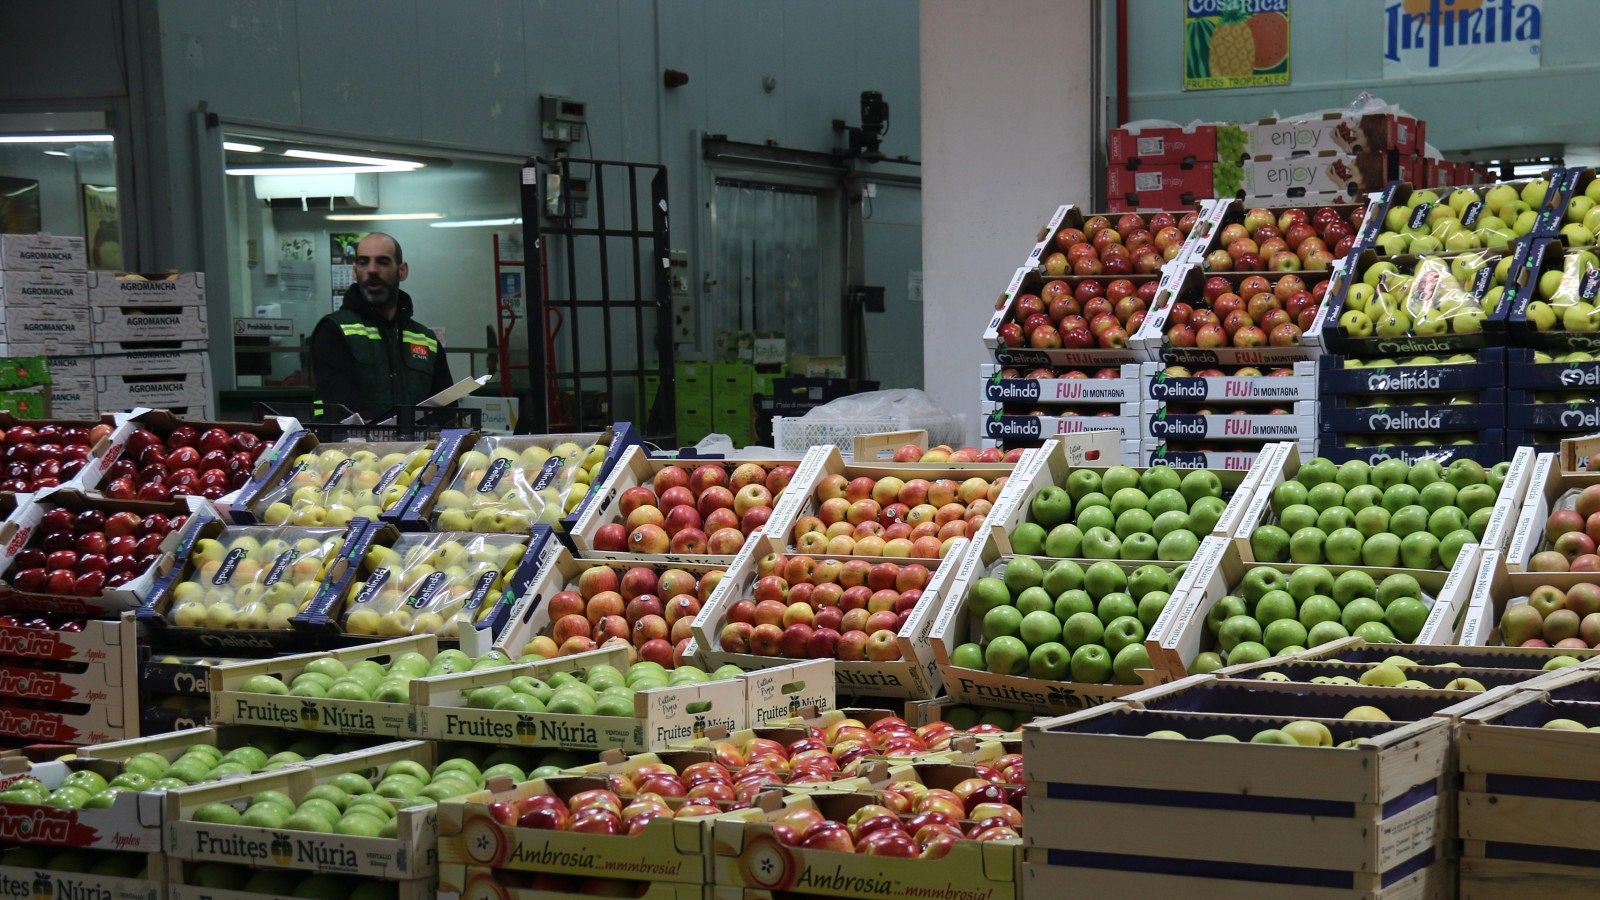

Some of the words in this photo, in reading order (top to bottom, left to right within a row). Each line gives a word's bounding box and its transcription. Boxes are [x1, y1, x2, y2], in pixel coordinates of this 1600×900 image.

[1384, 0, 1541, 67] Infinita
[1186, 78, 1225, 88] FRUTOS
[1228, 75, 1287, 86] TROPICALES
[1271, 127, 1321, 149] enjoy
[1266, 164, 1317, 186] enjoy
[20, 251, 72, 261] AGROMANCHA
[21, 287, 74, 297] AGROMANCHA
[121, 282, 176, 292] AGROMANCHA
[24, 323, 75, 332] AGROMANCHA
[127, 317, 180, 326] AGROMANCHA
[1378, 340, 1450, 354] Melinda
[47, 359, 78, 367] MANCHA
[129, 383, 184, 394] AGROMANCHA
[988, 382, 1039, 398] Melinda
[1056, 382, 1082, 398] FUJI
[1089, 388, 1125, 398] MONTAGNA
[1151, 380, 1207, 396] Melinda
[1225, 380, 1252, 397] FUJI
[1260, 386, 1298, 397] MONTAGNA
[1368, 368, 1440, 390] Melinda
[52, 393, 80, 401] MANCHA
[988, 420, 1039, 435] Melinda
[1151, 419, 1207, 434] Melinda
[1225, 418, 1251, 436] FUJI
[1260, 425, 1298, 435] MONTAGNA
[1369, 410, 1440, 430] Melinda
[479, 458, 506, 491] Melinda
[536, 456, 561, 490] Melinda
[215, 549, 241, 585] Melinda
[356, 568, 386, 602] Melinda
[414, 571, 445, 608] Melinda
[471, 572, 496, 607] Melinda
[0, 632, 54, 656] ivoira
[87, 647, 107, 664] Apples
[0, 672, 56, 697] ivoira
[86, 688, 108, 703] Apples
[957, 677, 1047, 707] Fruites
[0, 711, 58, 738] ivoira
[236, 699, 298, 728] Fruites
[322, 705, 376, 735] Núria
[757, 705, 788, 725] Fruites
[446, 714, 513, 743] Fruites
[541, 722, 599, 744] Núria
[657, 725, 692, 741] Fruites
[0, 805, 69, 842] ivoira
[110, 831, 140, 847] Apples
[196, 830, 268, 859] Fruites
[296, 838, 357, 867] Núria
[510, 841, 594, 870] Ambrosia
[57, 878, 112, 900] Núria
[796, 865, 893, 896] Ambrosia
